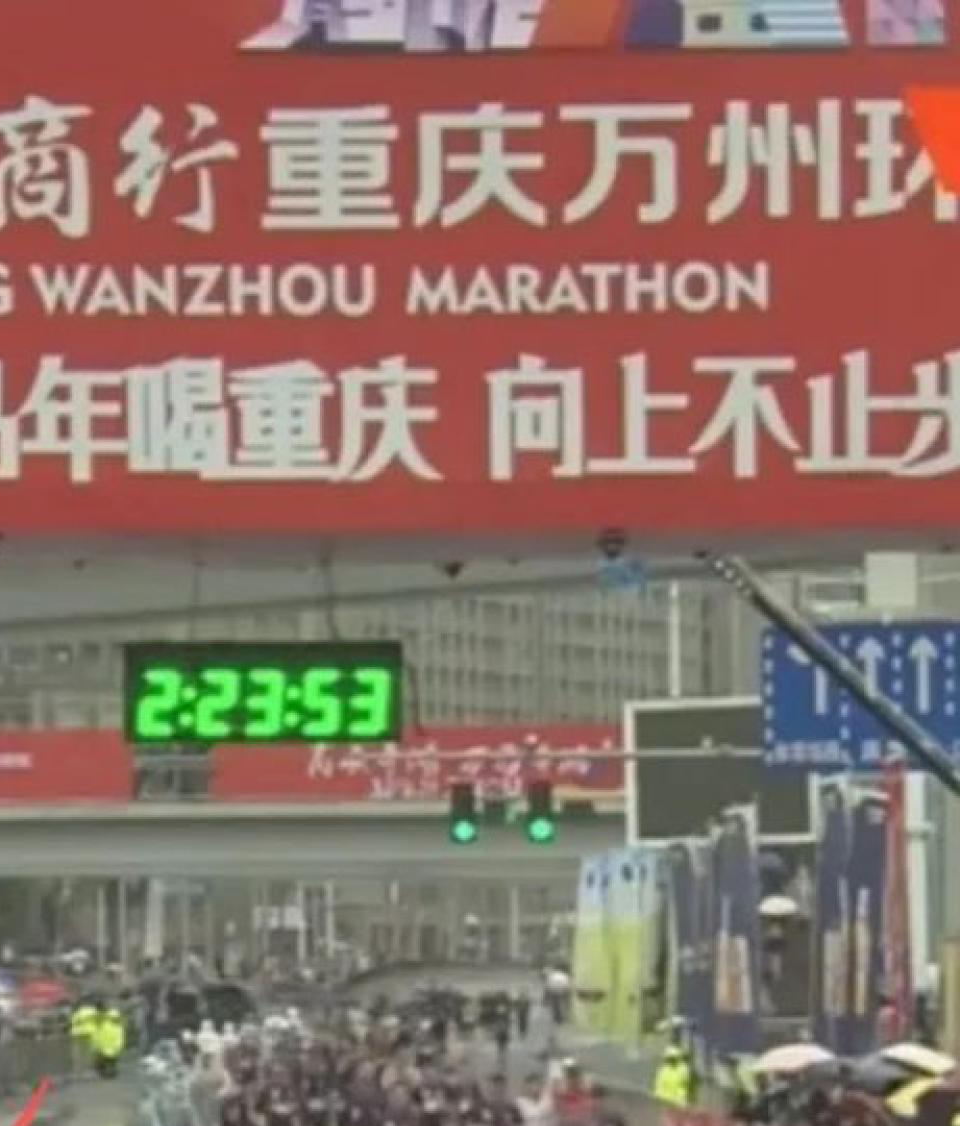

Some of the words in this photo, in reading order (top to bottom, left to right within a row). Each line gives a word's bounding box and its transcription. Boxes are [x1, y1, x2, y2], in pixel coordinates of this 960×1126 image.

[29, 263, 376, 317] WANZHOU
[406, 261, 770, 314] MARATHON
[135, 667, 393, 738] 2:23:53
